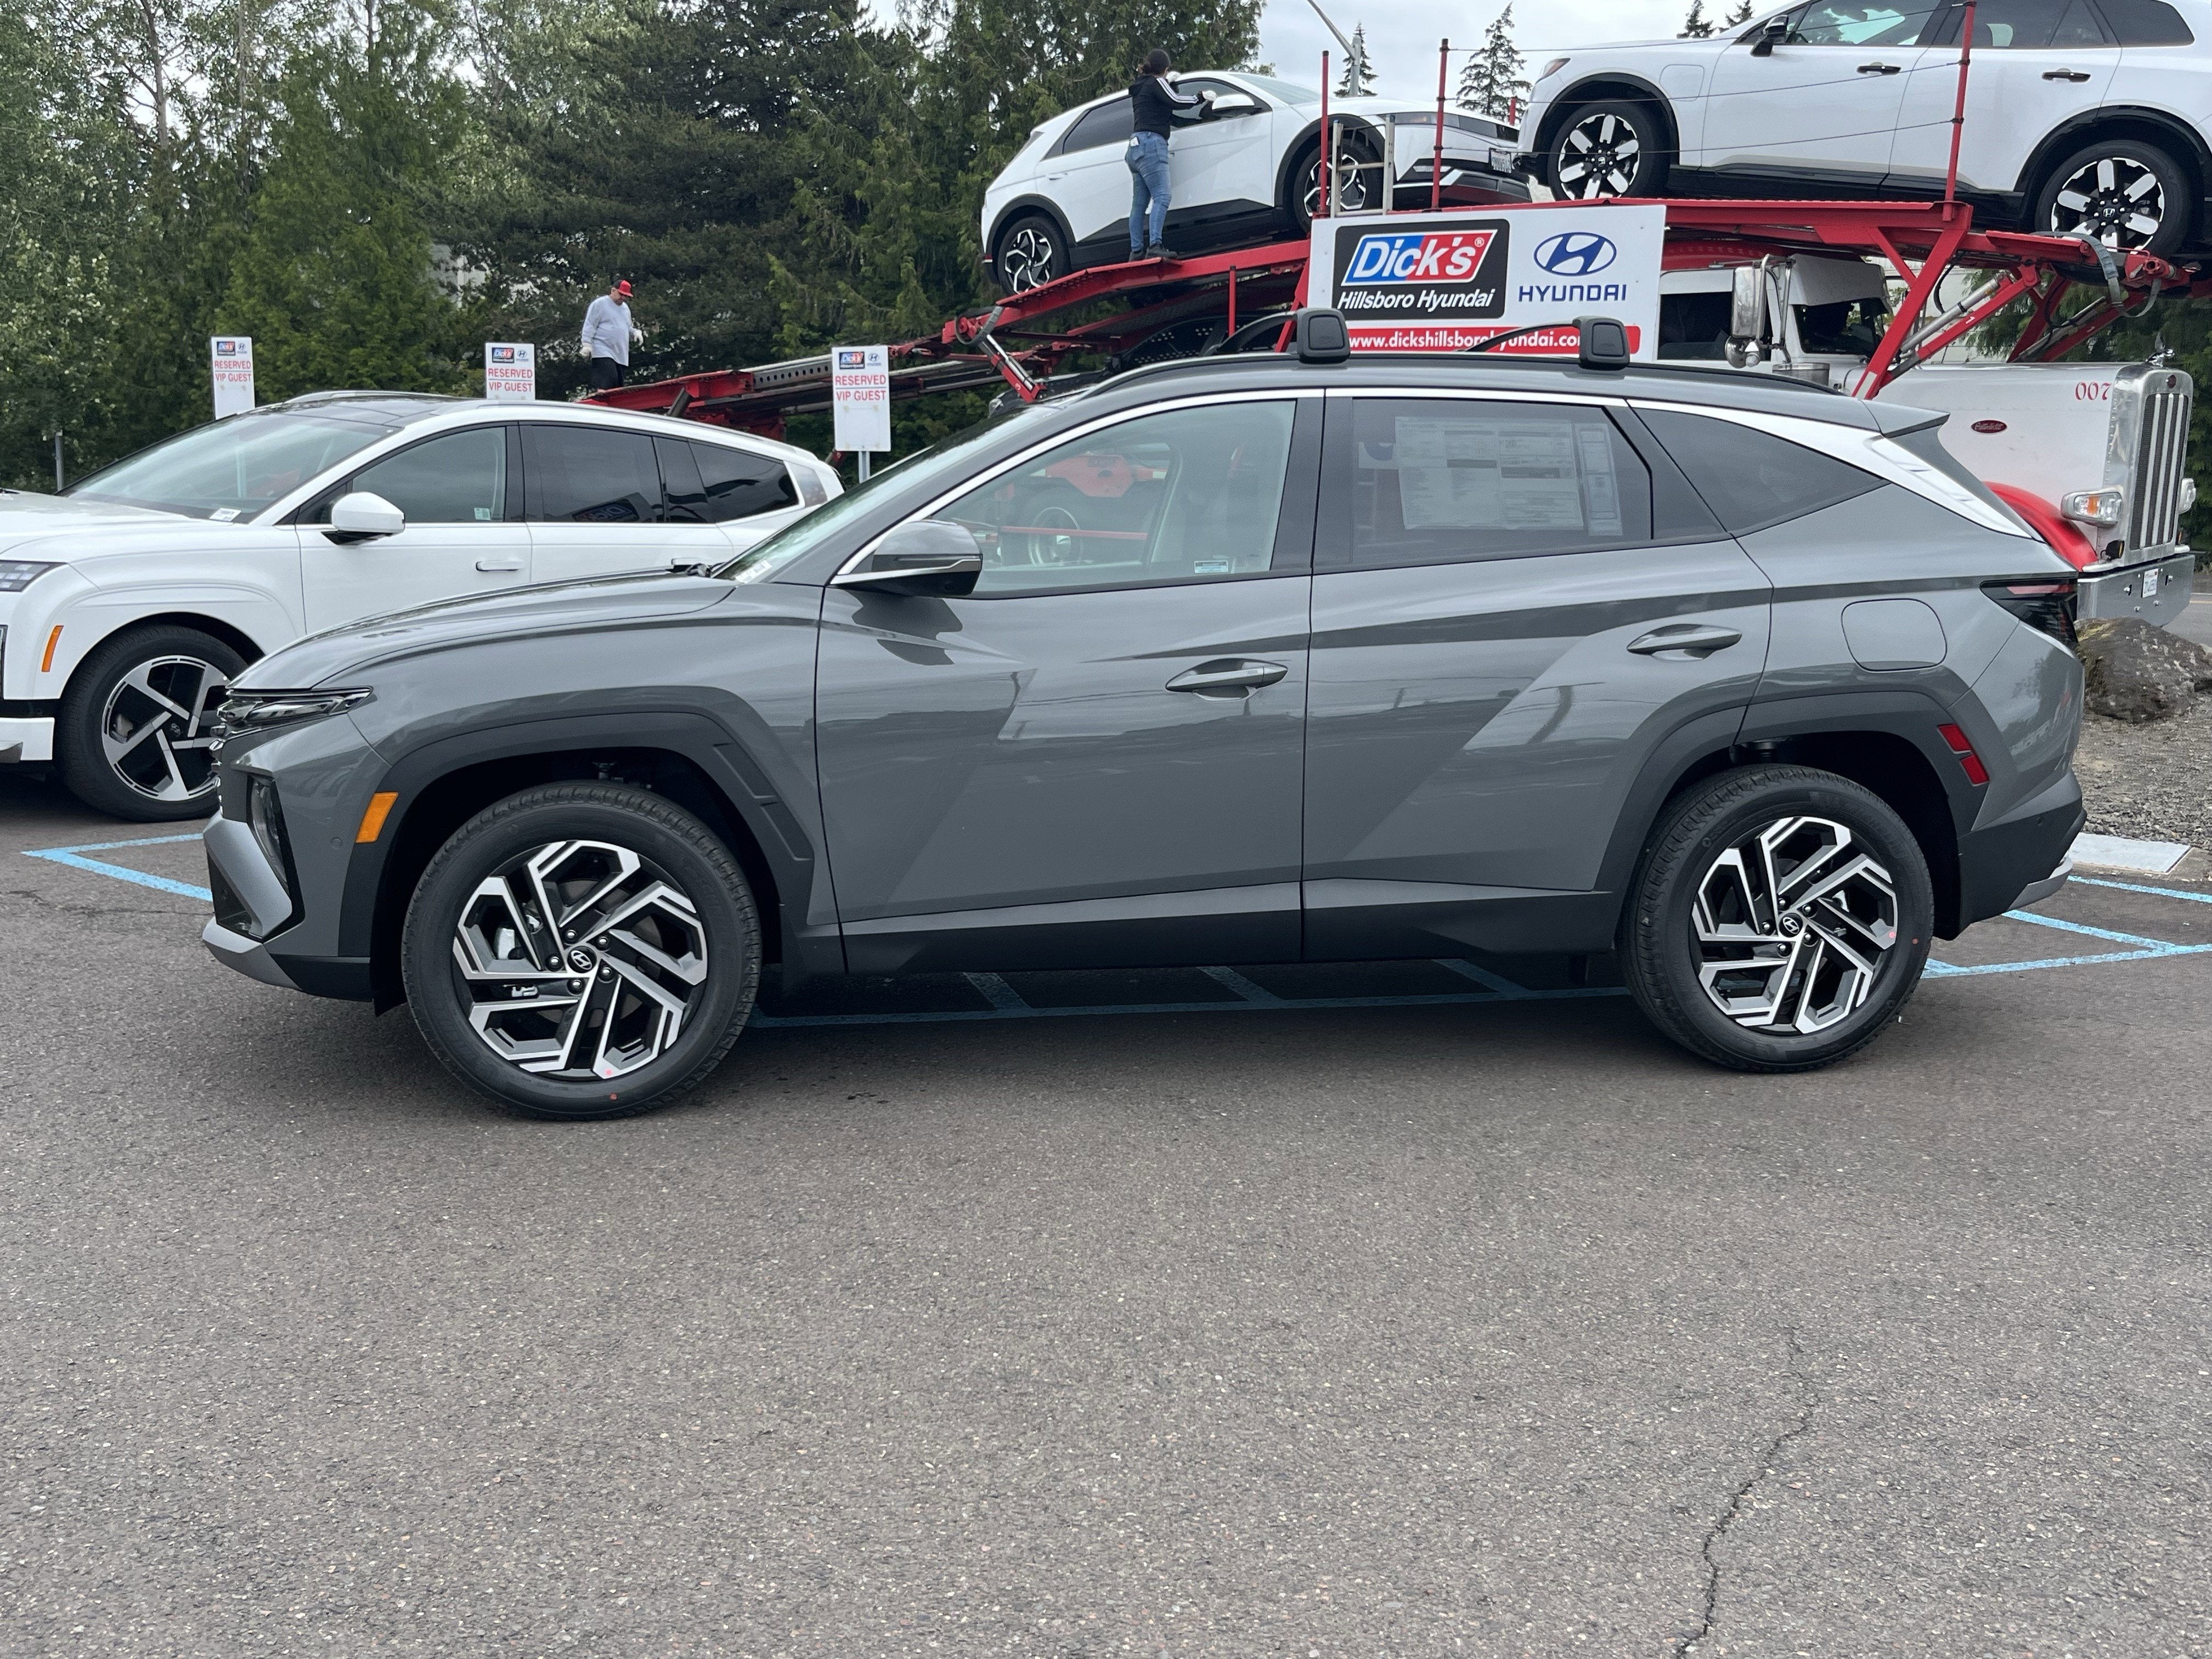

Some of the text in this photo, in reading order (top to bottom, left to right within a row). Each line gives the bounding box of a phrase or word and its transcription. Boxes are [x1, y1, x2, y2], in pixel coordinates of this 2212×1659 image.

[1353, 236, 1476, 278] Dick's
[1519, 284, 1627, 302] HYUNDAI
[1337, 288, 1496, 312] Hillsboro Hyundai
[215, 360, 251, 369] RESERVED
[215, 374, 251, 382] VIP GUEST
[488, 368, 533, 378] RESERVED
[835, 375, 886, 386] RESERVED
[489, 382, 533, 392] VIP GUEST
[2075, 381, 2112, 400] 007
[836, 390, 886, 401] VIP GUEST
